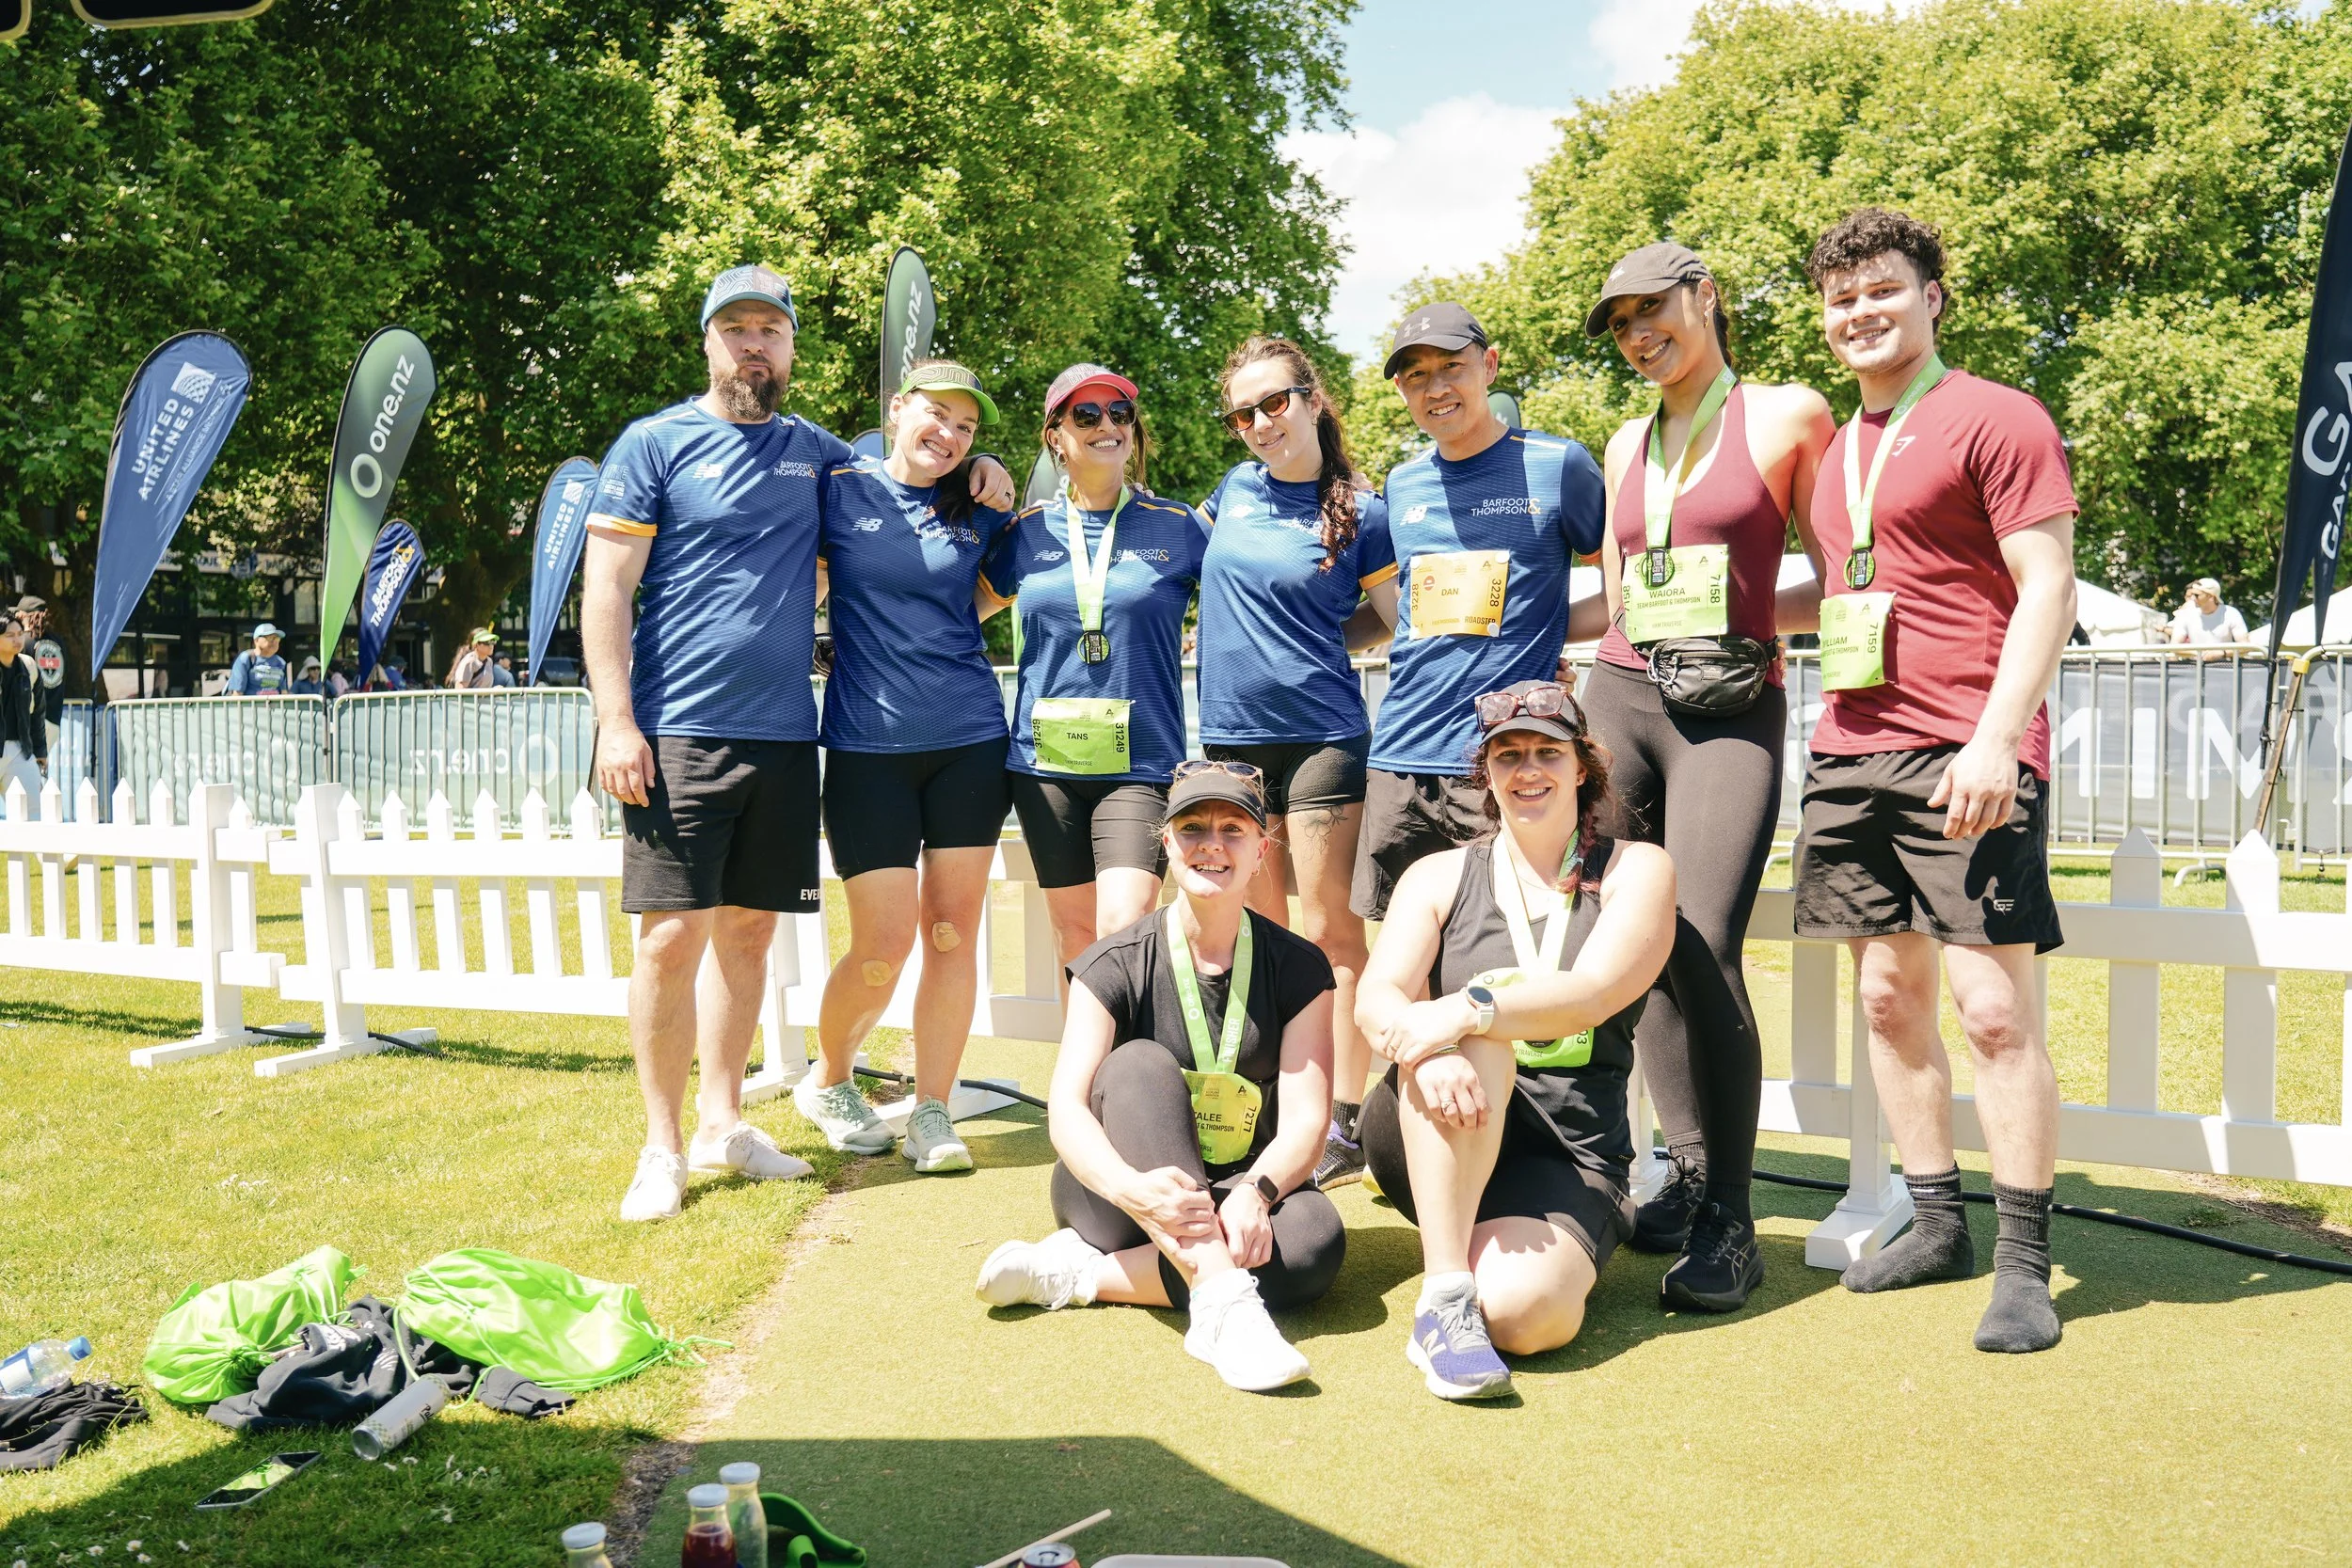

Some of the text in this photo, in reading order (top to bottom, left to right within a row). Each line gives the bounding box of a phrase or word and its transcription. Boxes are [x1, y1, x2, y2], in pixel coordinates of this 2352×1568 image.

[370, 355, 415, 453] one.nz
[132, 398, 180, 474] UNITED
[138, 404, 195, 501] AIRLINES
[779, 460, 810, 470] BARFOOT
[773, 467, 811, 477] THOMPSON
[1470, 505, 1528, 516] THOMPSON
[1483, 498, 1541, 515] BARFOOT &
[544, 502, 567, 555] UNITED
[548, 506, 576, 570] AIRLINES
[1110, 554, 1159, 563] HOMPSON
[1116, 548, 1161, 557] BARFOOT
[370, 555, 408, 628] THOMPSON
[1411, 583, 1420, 611] 3228
[1441, 588, 1459, 596] DAN
[1489, 578, 1502, 608] 3228
[1648, 587, 1686, 599] WAIORA
[1648, 599, 1669, 609] BARFOOT
[1674, 596, 1701, 605] THOMPSON
[1709, 574, 1721, 604] 7158
[1867, 622, 1880, 654] 7159
[1032, 719, 1043, 749] 31249
[1066, 732, 1089, 740] TANS
[1115, 722, 1125, 753] 31249
[800, 888, 820, 900] EVE
[1182, 977, 1196, 1007] one.nz
[1222, 1017, 1241, 1064] FINISHER
[1518, 1048, 1544, 1058] TRAVERSE
[1205, 1123, 1235, 1132] THOMPSON
[1243, 1105, 1258, 1133] 7277
